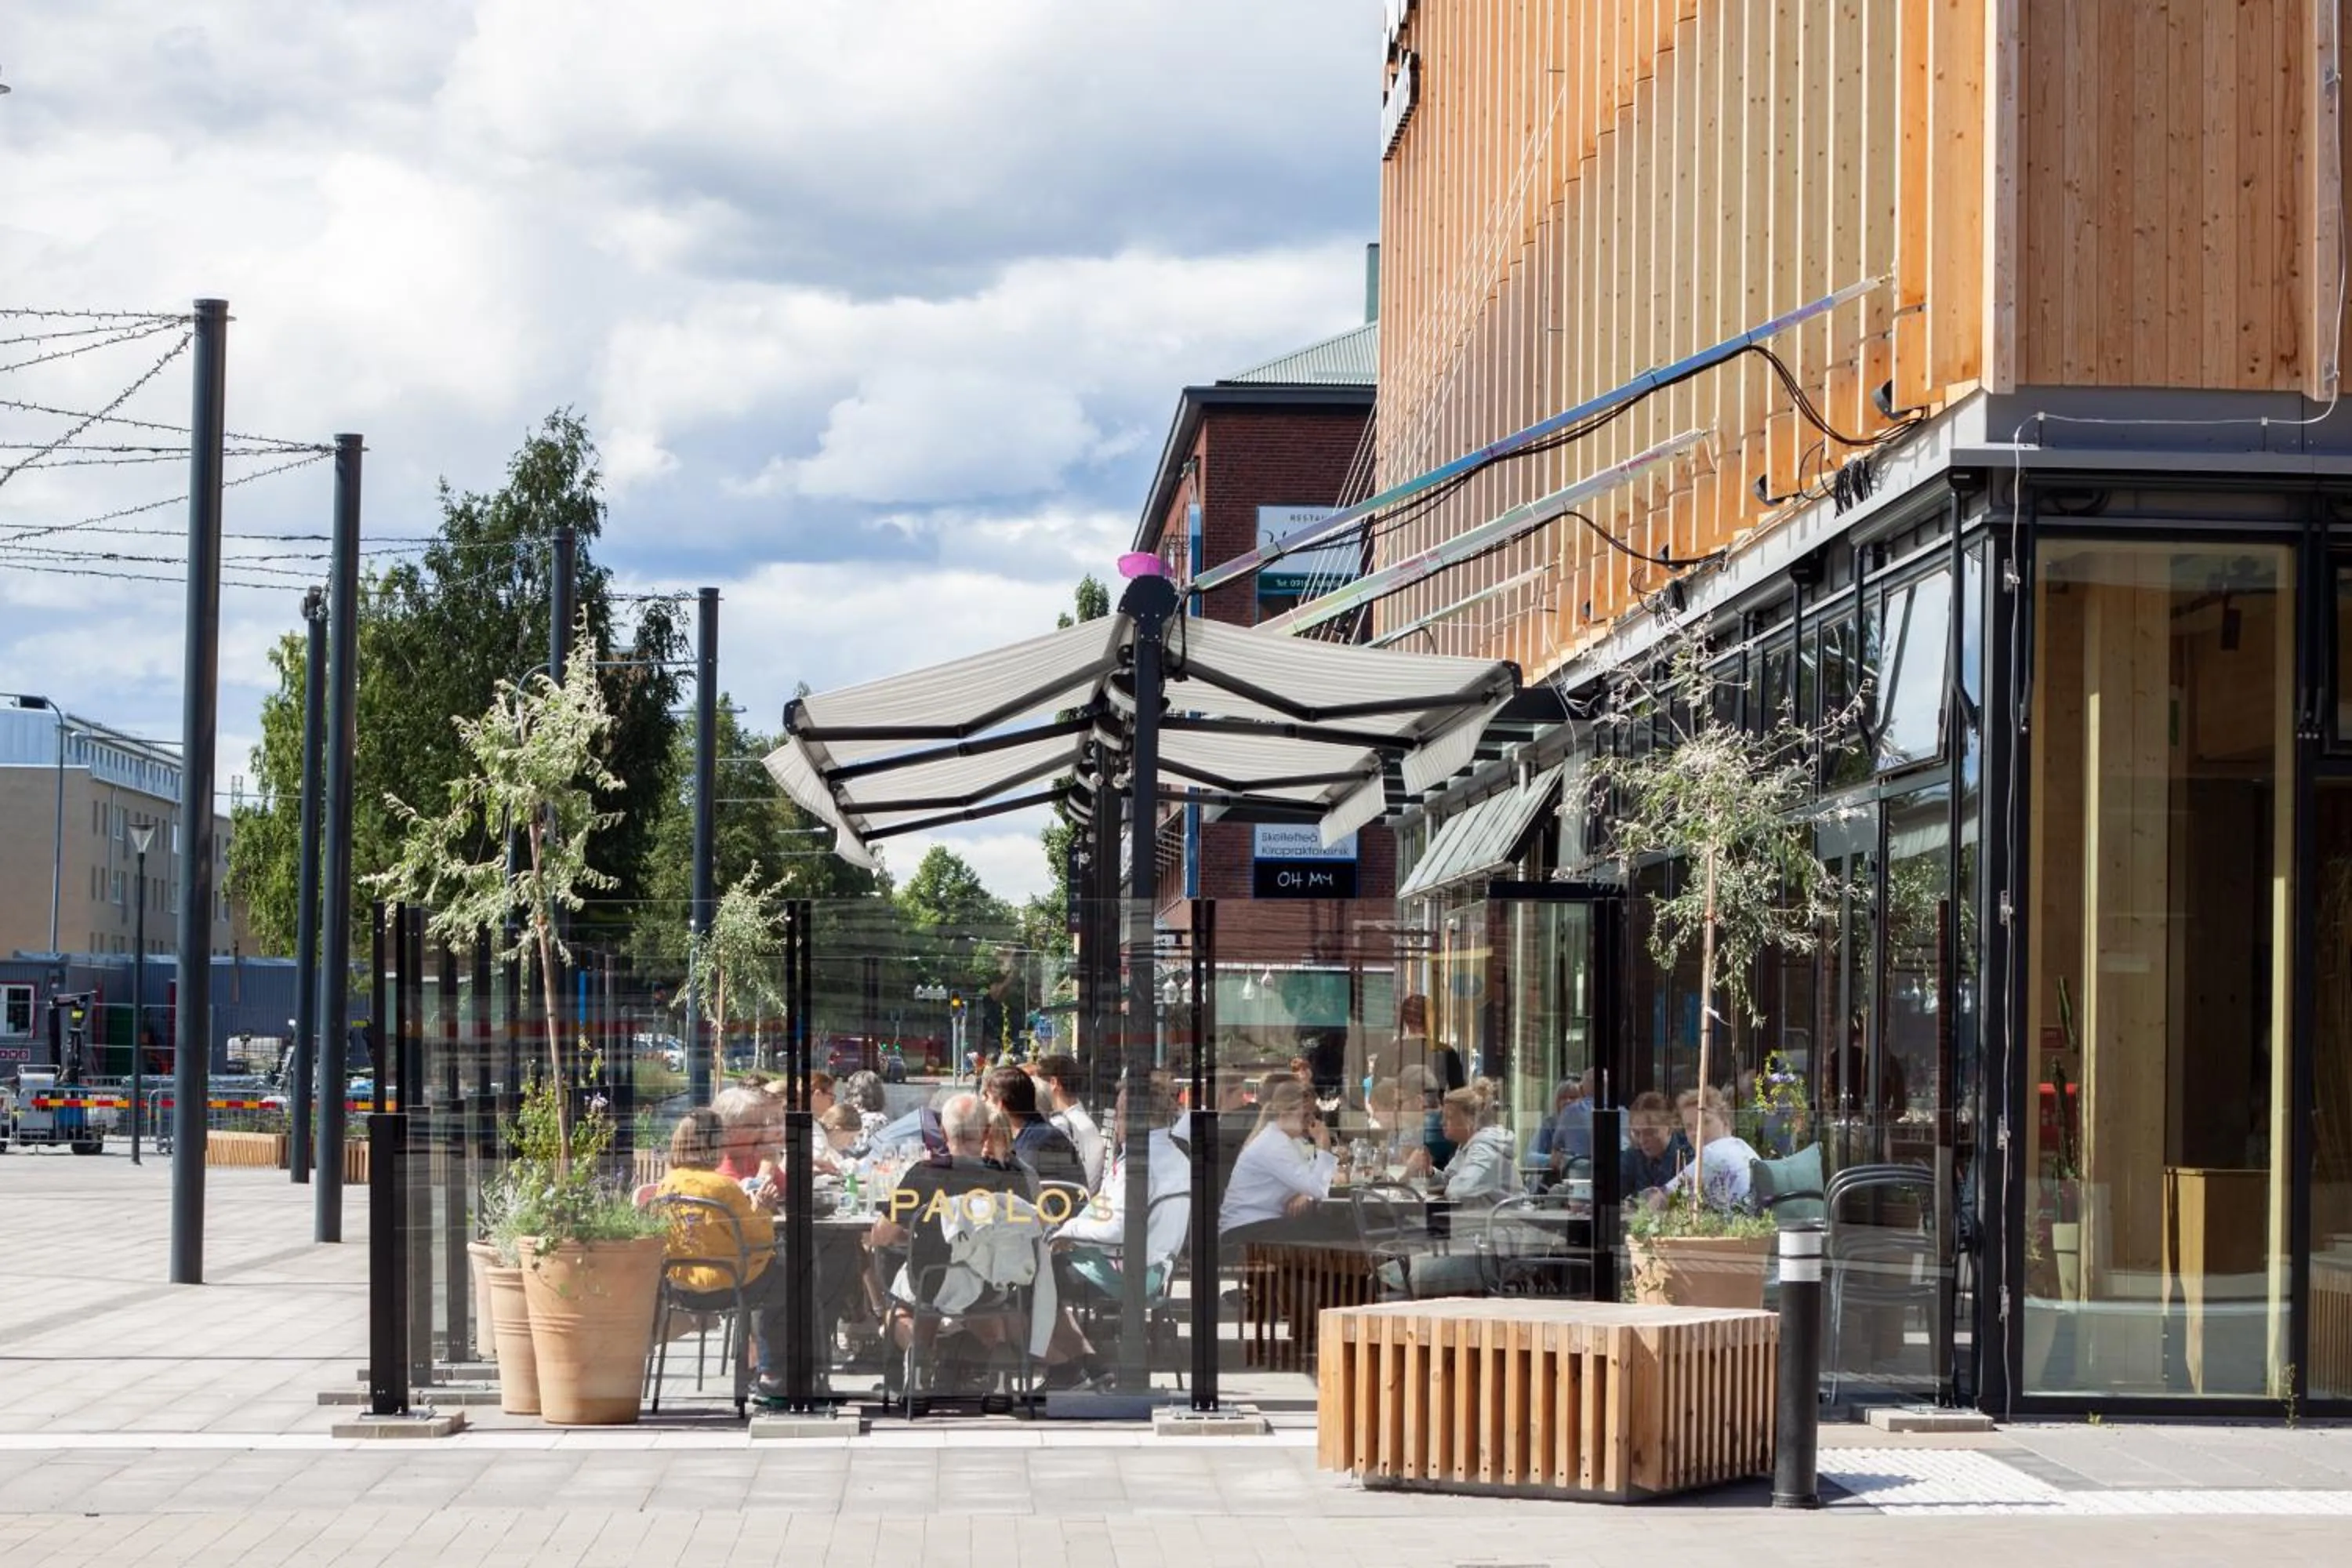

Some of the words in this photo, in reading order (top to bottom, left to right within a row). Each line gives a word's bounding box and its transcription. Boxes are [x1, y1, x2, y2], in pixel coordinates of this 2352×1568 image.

[1277, 871, 1303, 888] OH
[1308, 871, 1334, 887] MY
[890, 1187, 1114, 1223] PAOLO'S
